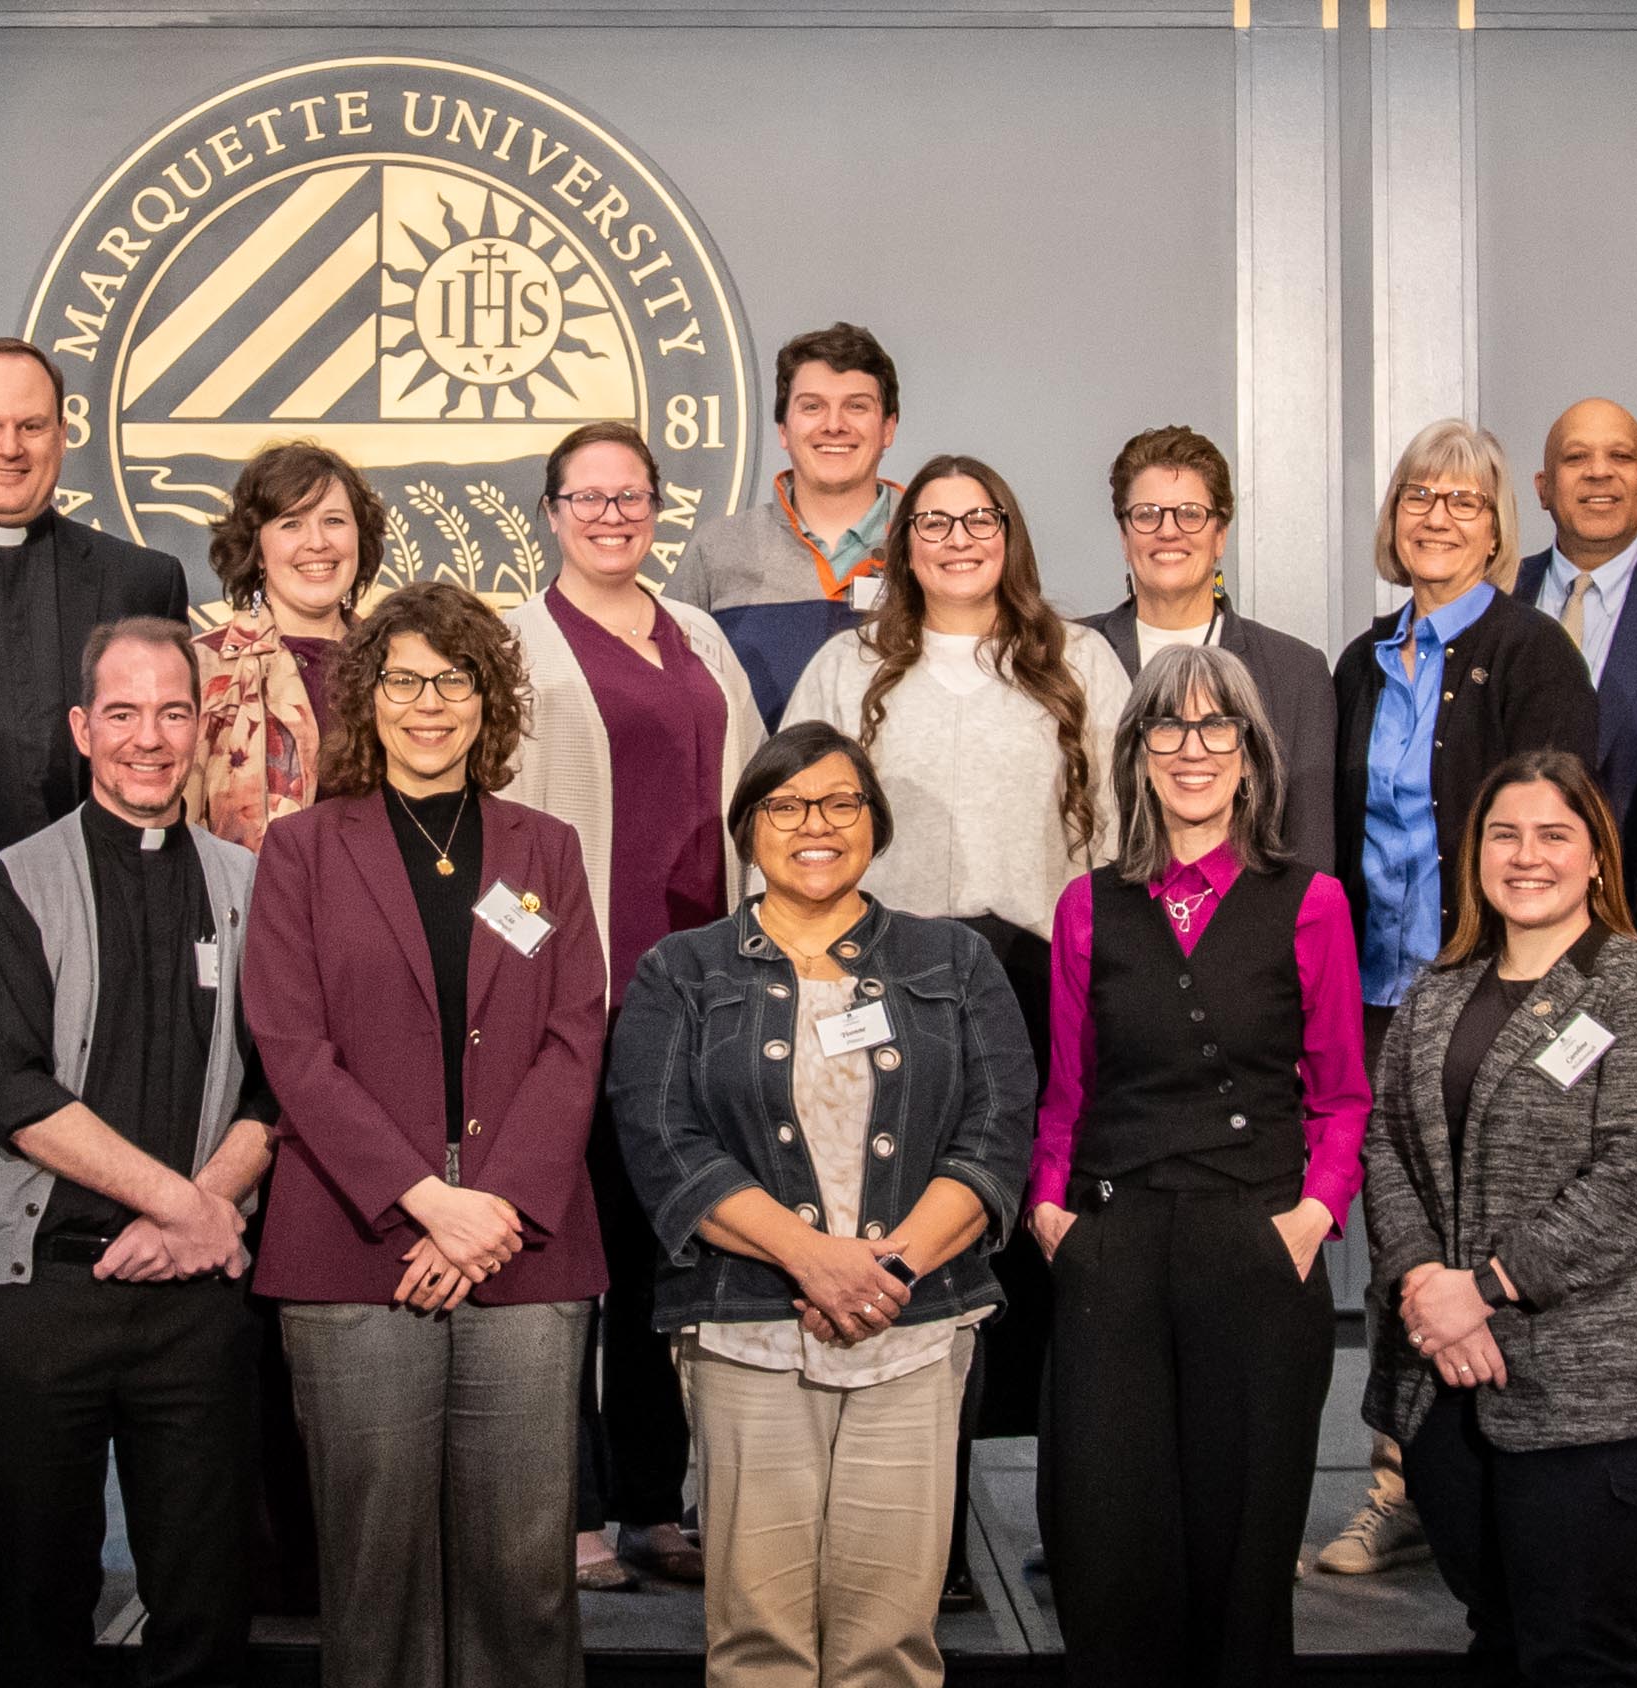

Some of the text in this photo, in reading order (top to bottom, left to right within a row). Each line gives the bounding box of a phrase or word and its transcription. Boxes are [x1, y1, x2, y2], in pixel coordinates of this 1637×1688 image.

[53, 90, 706, 362] MARQUETTE UNIVERSITY
[435, 269, 550, 349] IHS
[63, 393, 725, 449] 8 81
